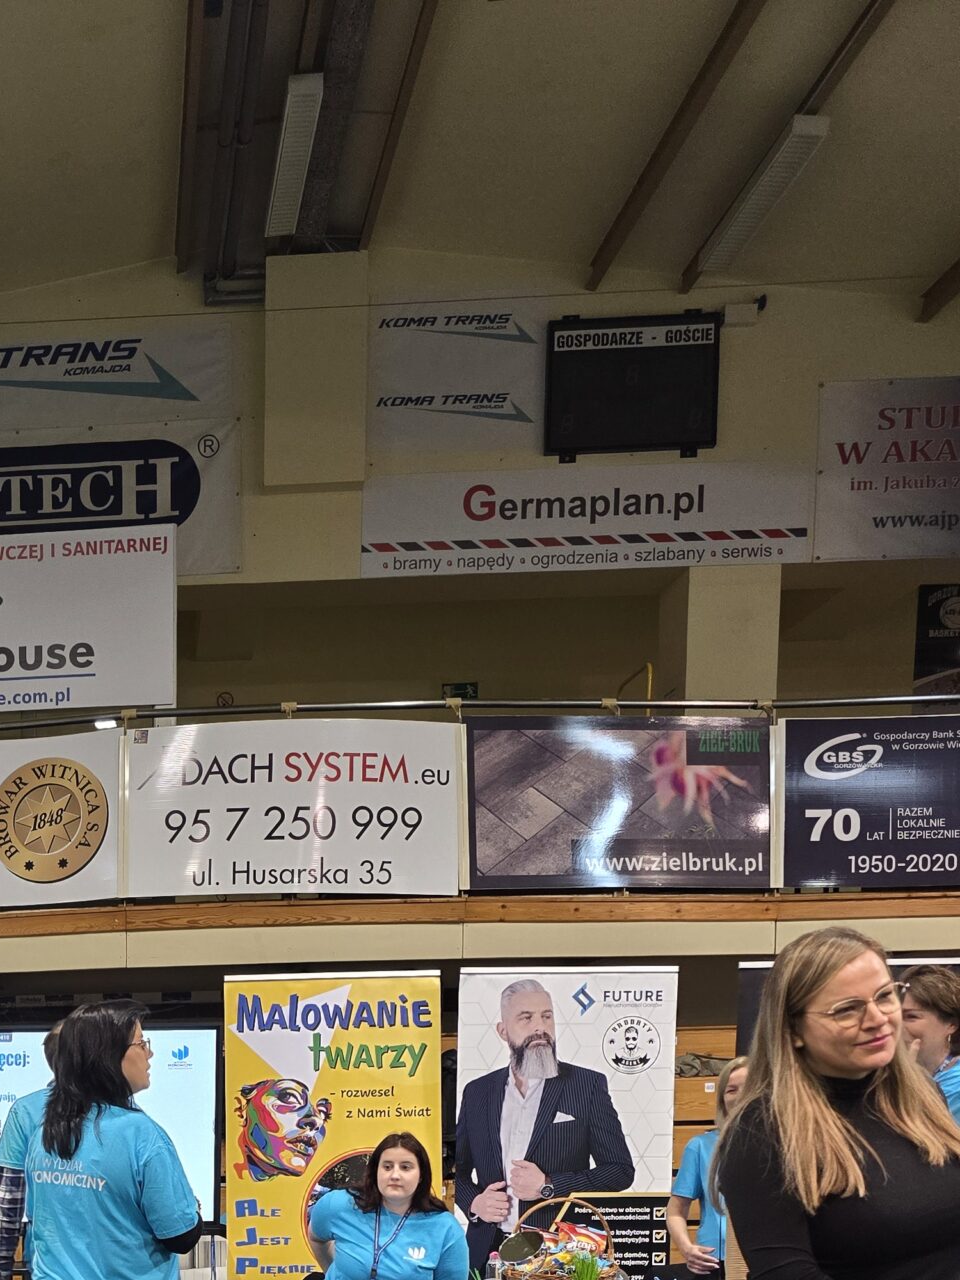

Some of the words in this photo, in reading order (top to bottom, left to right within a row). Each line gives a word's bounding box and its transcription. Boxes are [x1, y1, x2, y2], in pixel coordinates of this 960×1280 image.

[378, 316, 437, 329] KOMA
[444, 313, 513, 326] TRANS
[556, 331, 643, 349] GOSPODARZE
[665, 326, 714, 344] GOŚCIE
[63, 364, 131, 377] KOMAJDA
[375, 395, 435, 408] KOMA
[441, 393, 509, 405] TRANS
[835, 442, 872, 465] W
[850, 478, 878, 491] im.
[883, 475, 947, 493] Jakuba
[463, 483, 705, 524] Germaplan.pl
[50, 543, 55, 557] I
[62, 536, 168, 557] SANITARNEJ
[393, 555, 442, 572] bramy
[457, 552, 515, 571] napędy
[531, 548, 618, 567] ogrodzenia
[634, 545, 705, 565] szlabany
[721, 543, 772, 559] serwis
[700, 730, 760, 752] ZIEL-BRUK
[874, 732, 930, 741] Gospodarczy
[823, 751, 864, 763] GBS
[181, 753, 274, 786] DACH
[31, 764, 100, 816] WITNICA
[31, 808, 64, 831] 1848
[897, 807, 932, 816] RAZEM
[164, 808, 211, 843] 95
[225, 807, 250, 842] 7
[263, 805, 336, 841] 250
[351, 805, 423, 841] 999
[805, 808, 860, 842] 70
[867, 832, 885, 841] LAT
[897, 819, 945, 828] LOKALNIE
[897, 830, 960, 839] BEZPIECZNIE
[192, 859, 220, 887] ul.
[232, 857, 348, 885] Husarska
[359, 860, 392, 885] 35
[586, 852, 764, 874] www.zielbruk.pl
[848, 854, 958, 873] 1950-2020
[603, 991, 663, 1002] FUTURE
[308, 1032, 428, 1077] twarzy
[340, 1086, 395, 1099] rozwesel
[345, 1110, 352, 1119] z
[357, 1106, 391, 1119] Nami
[396, 1103, 431, 1118] Świat
